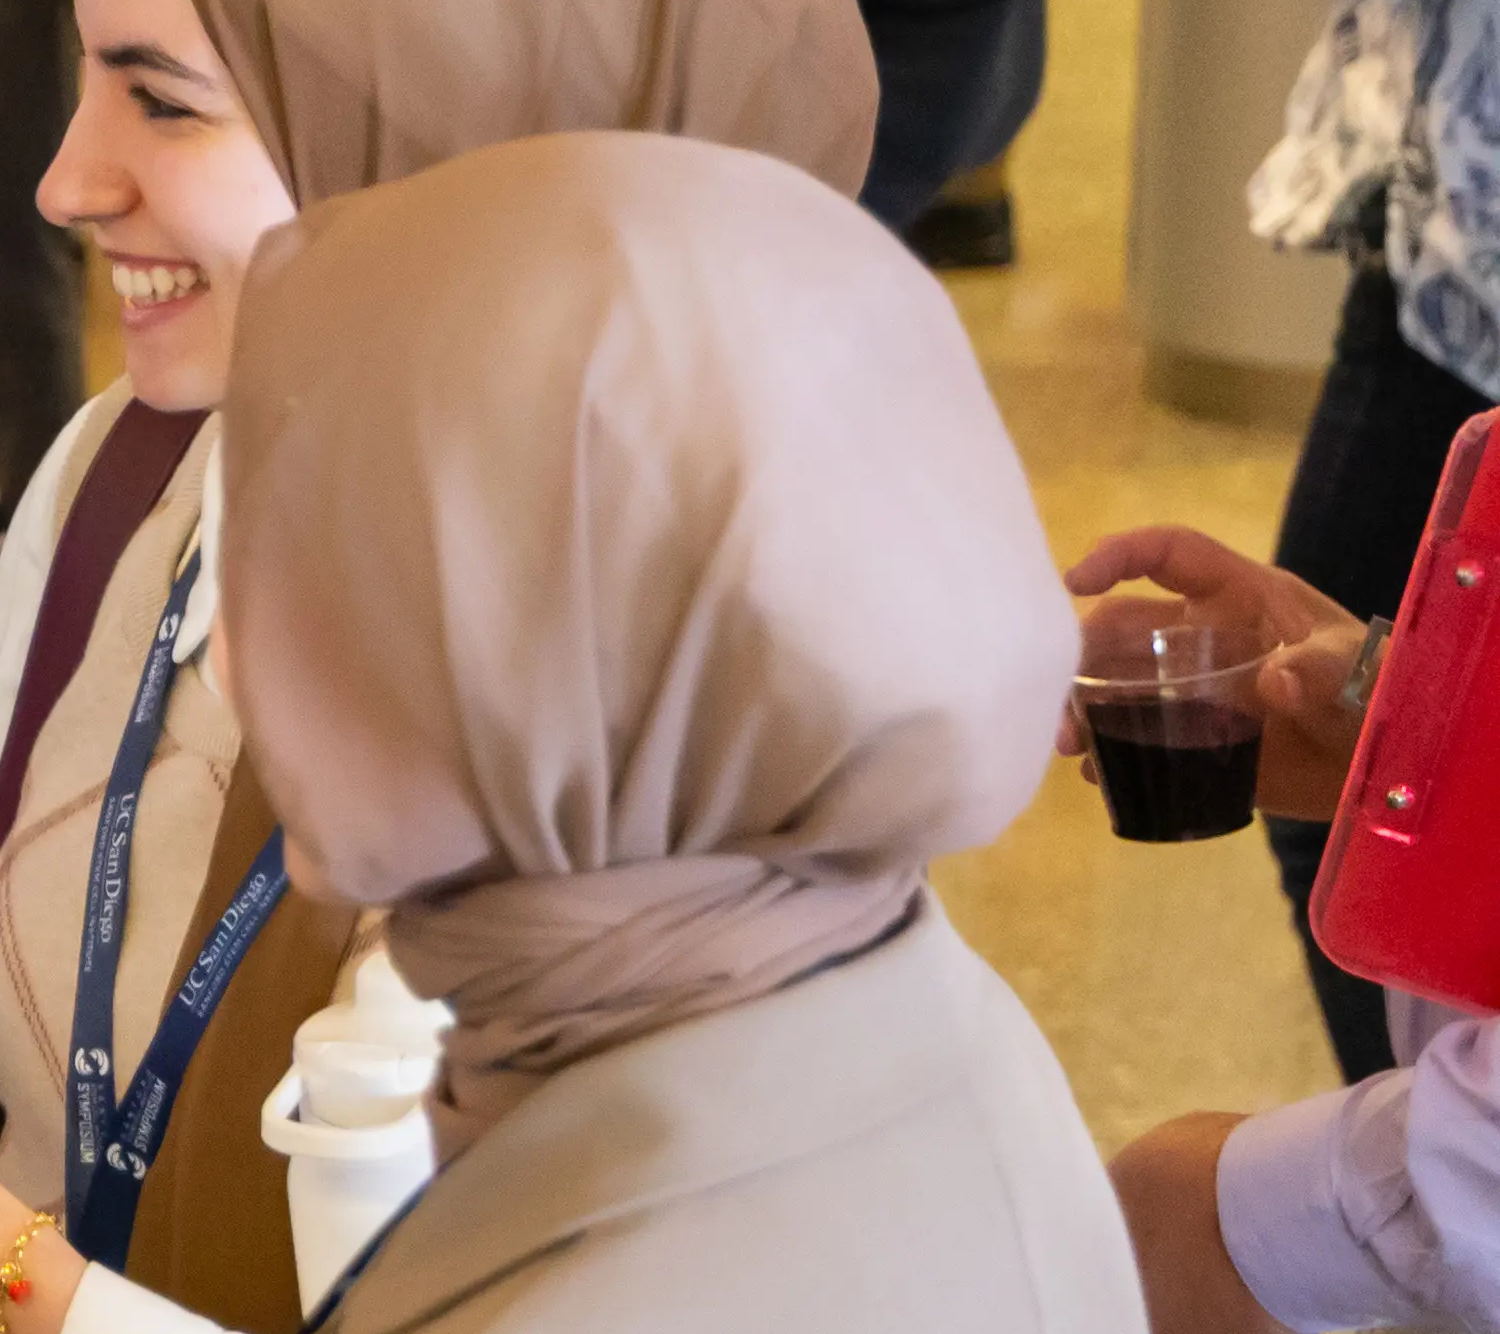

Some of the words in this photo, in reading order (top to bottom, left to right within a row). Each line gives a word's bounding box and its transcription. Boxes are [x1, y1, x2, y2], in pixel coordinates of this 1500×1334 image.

[114, 792, 136, 828] UC
[106, 832, 128, 875] San
[99, 877, 123, 944] Diego
[179, 967, 206, 1008] UC
[197, 929, 230, 975] San
[220, 871, 267, 928] Diego
[77, 1081, 97, 1164] SYMPOSIUM
[134, 1077, 169, 1153] SYMPOSIUM
